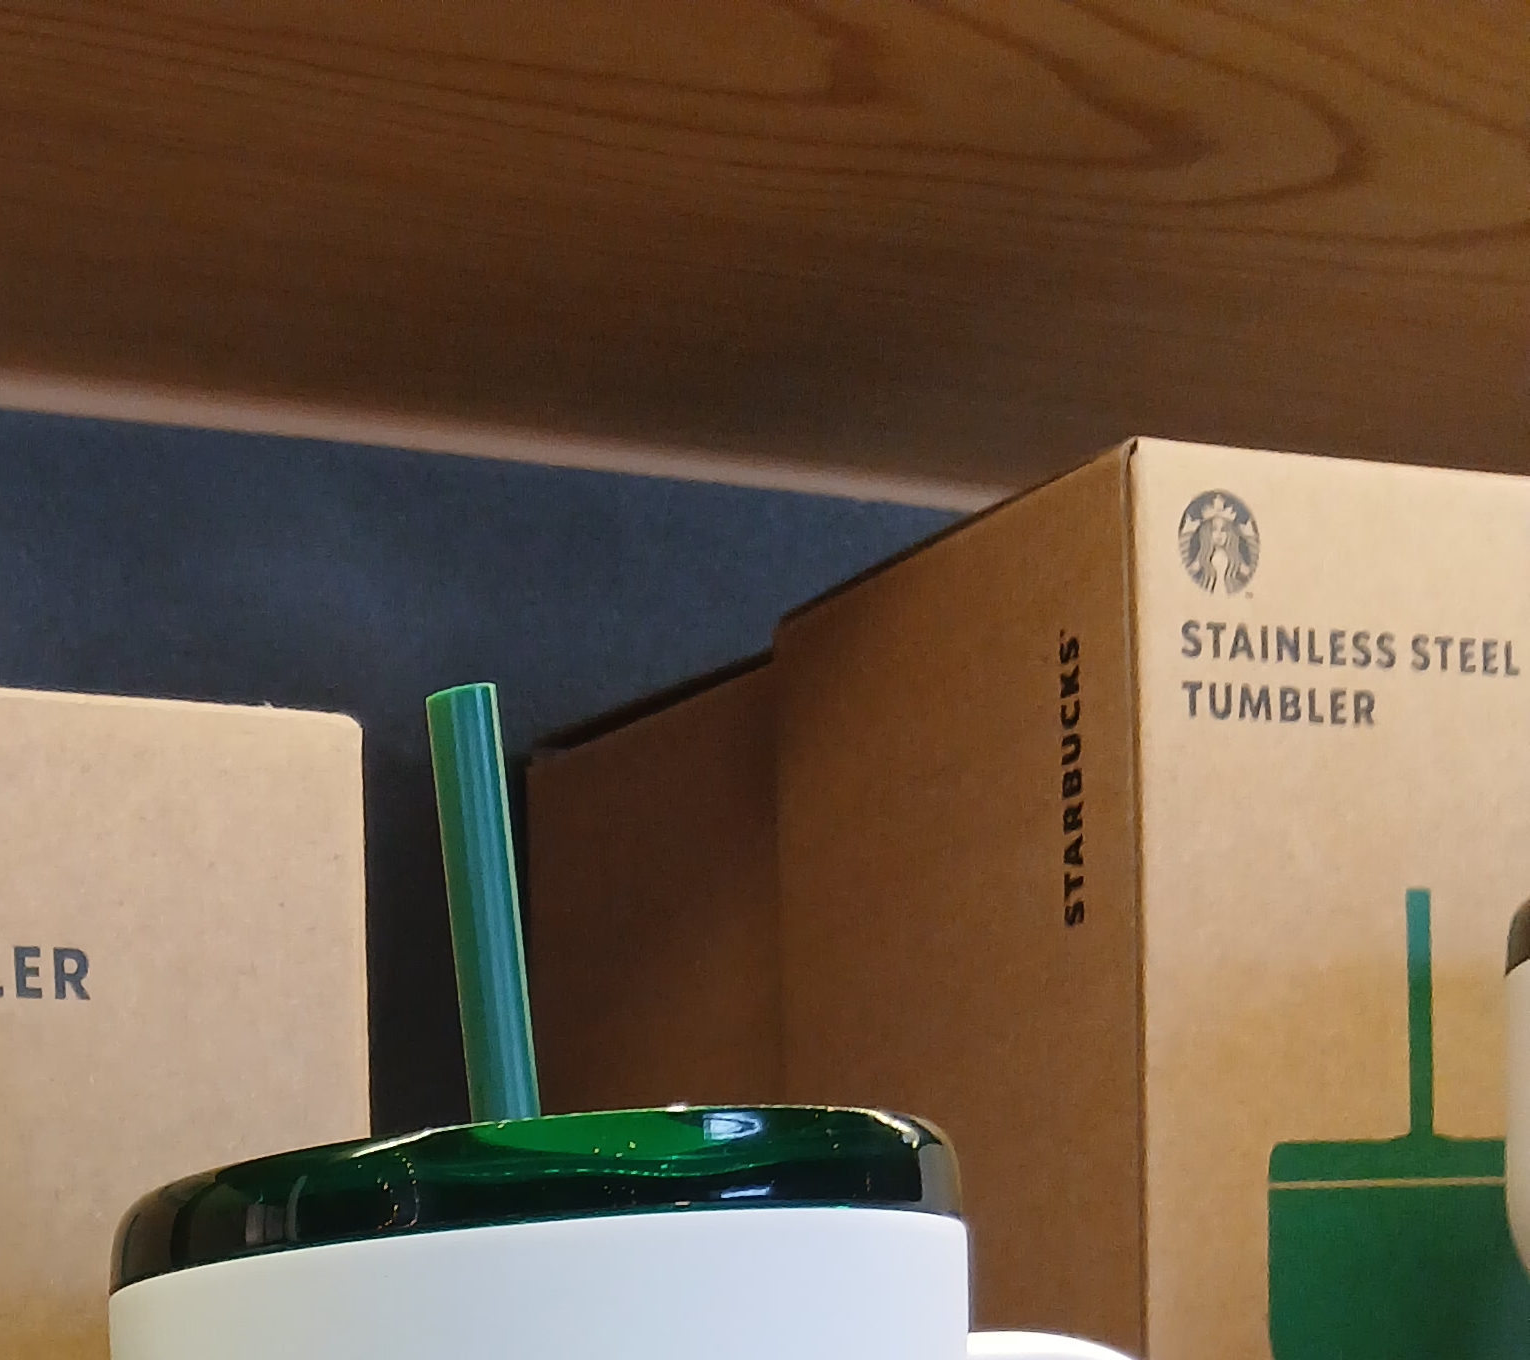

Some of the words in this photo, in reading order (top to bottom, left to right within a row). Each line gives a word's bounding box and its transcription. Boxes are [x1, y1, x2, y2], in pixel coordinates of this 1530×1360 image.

[1181, 620, 1396, 669] STAINLESS
[1410, 634, 1520, 676] STEEL
[1181, 680, 1376, 726] TUMBLER
[1059, 634, 1085, 928] STARBUCKS
